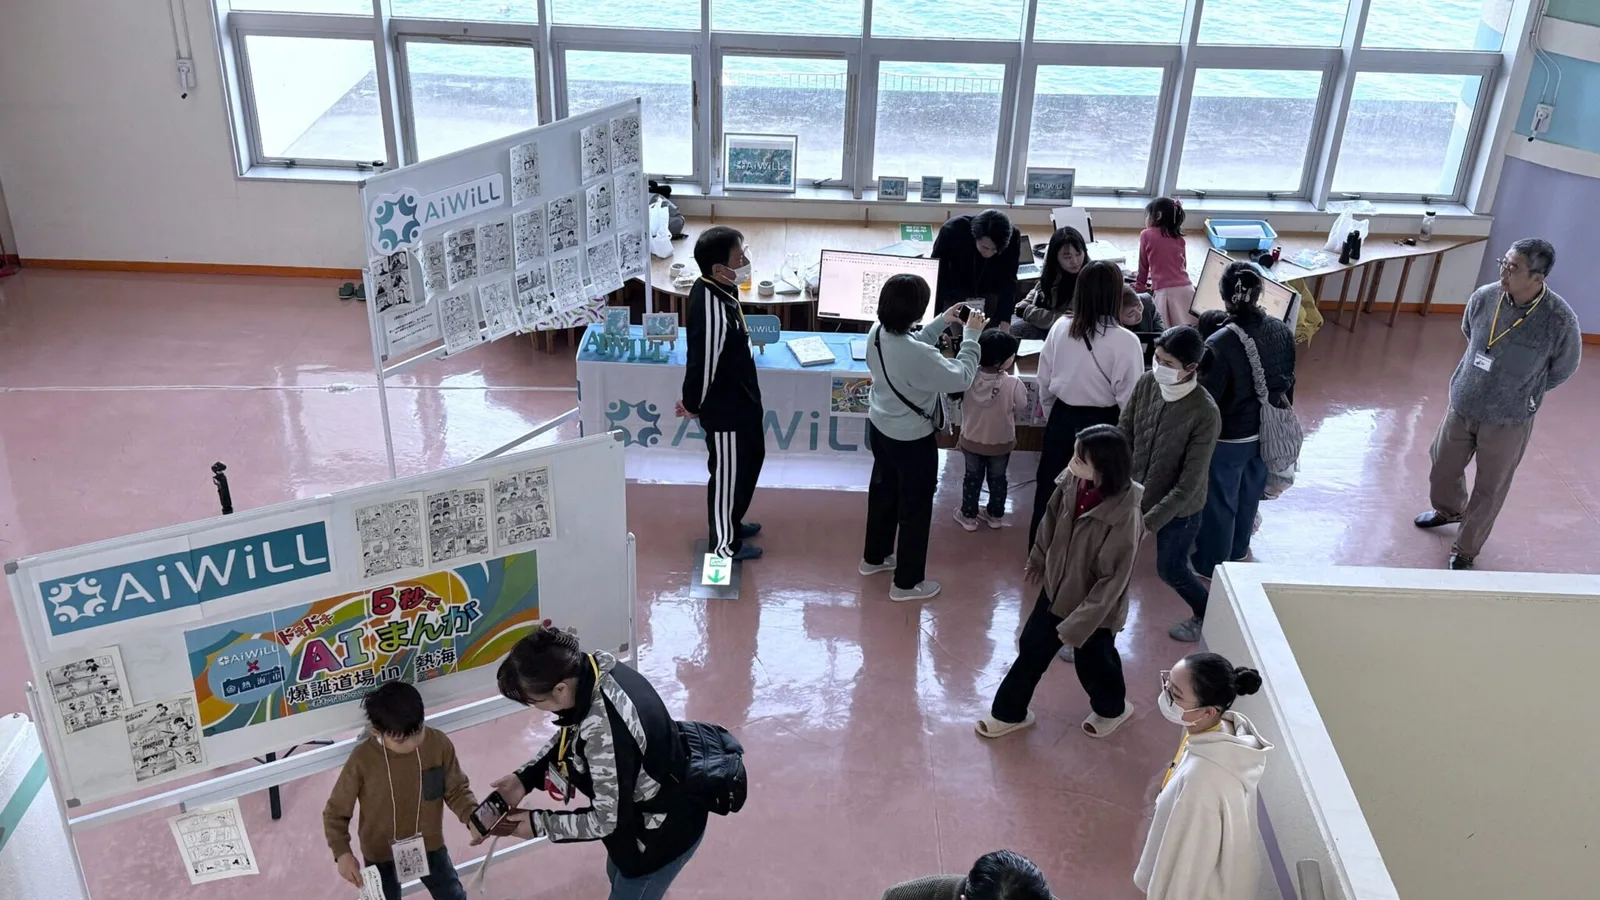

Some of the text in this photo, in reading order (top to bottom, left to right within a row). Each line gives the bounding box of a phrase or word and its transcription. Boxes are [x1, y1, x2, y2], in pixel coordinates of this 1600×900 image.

[425, 182, 500, 223] AiWiLL
[111, 533, 327, 611] AiWiLL
[371, 586, 441, 616] 5秒で
[278, 614, 334, 646] ドキドキ
[230, 644, 280, 664] AiWiLL
[287, 667, 375, 704] 爆誕道場
[381, 665, 400, 681] in
[415, 648, 456, 673] 熱海
